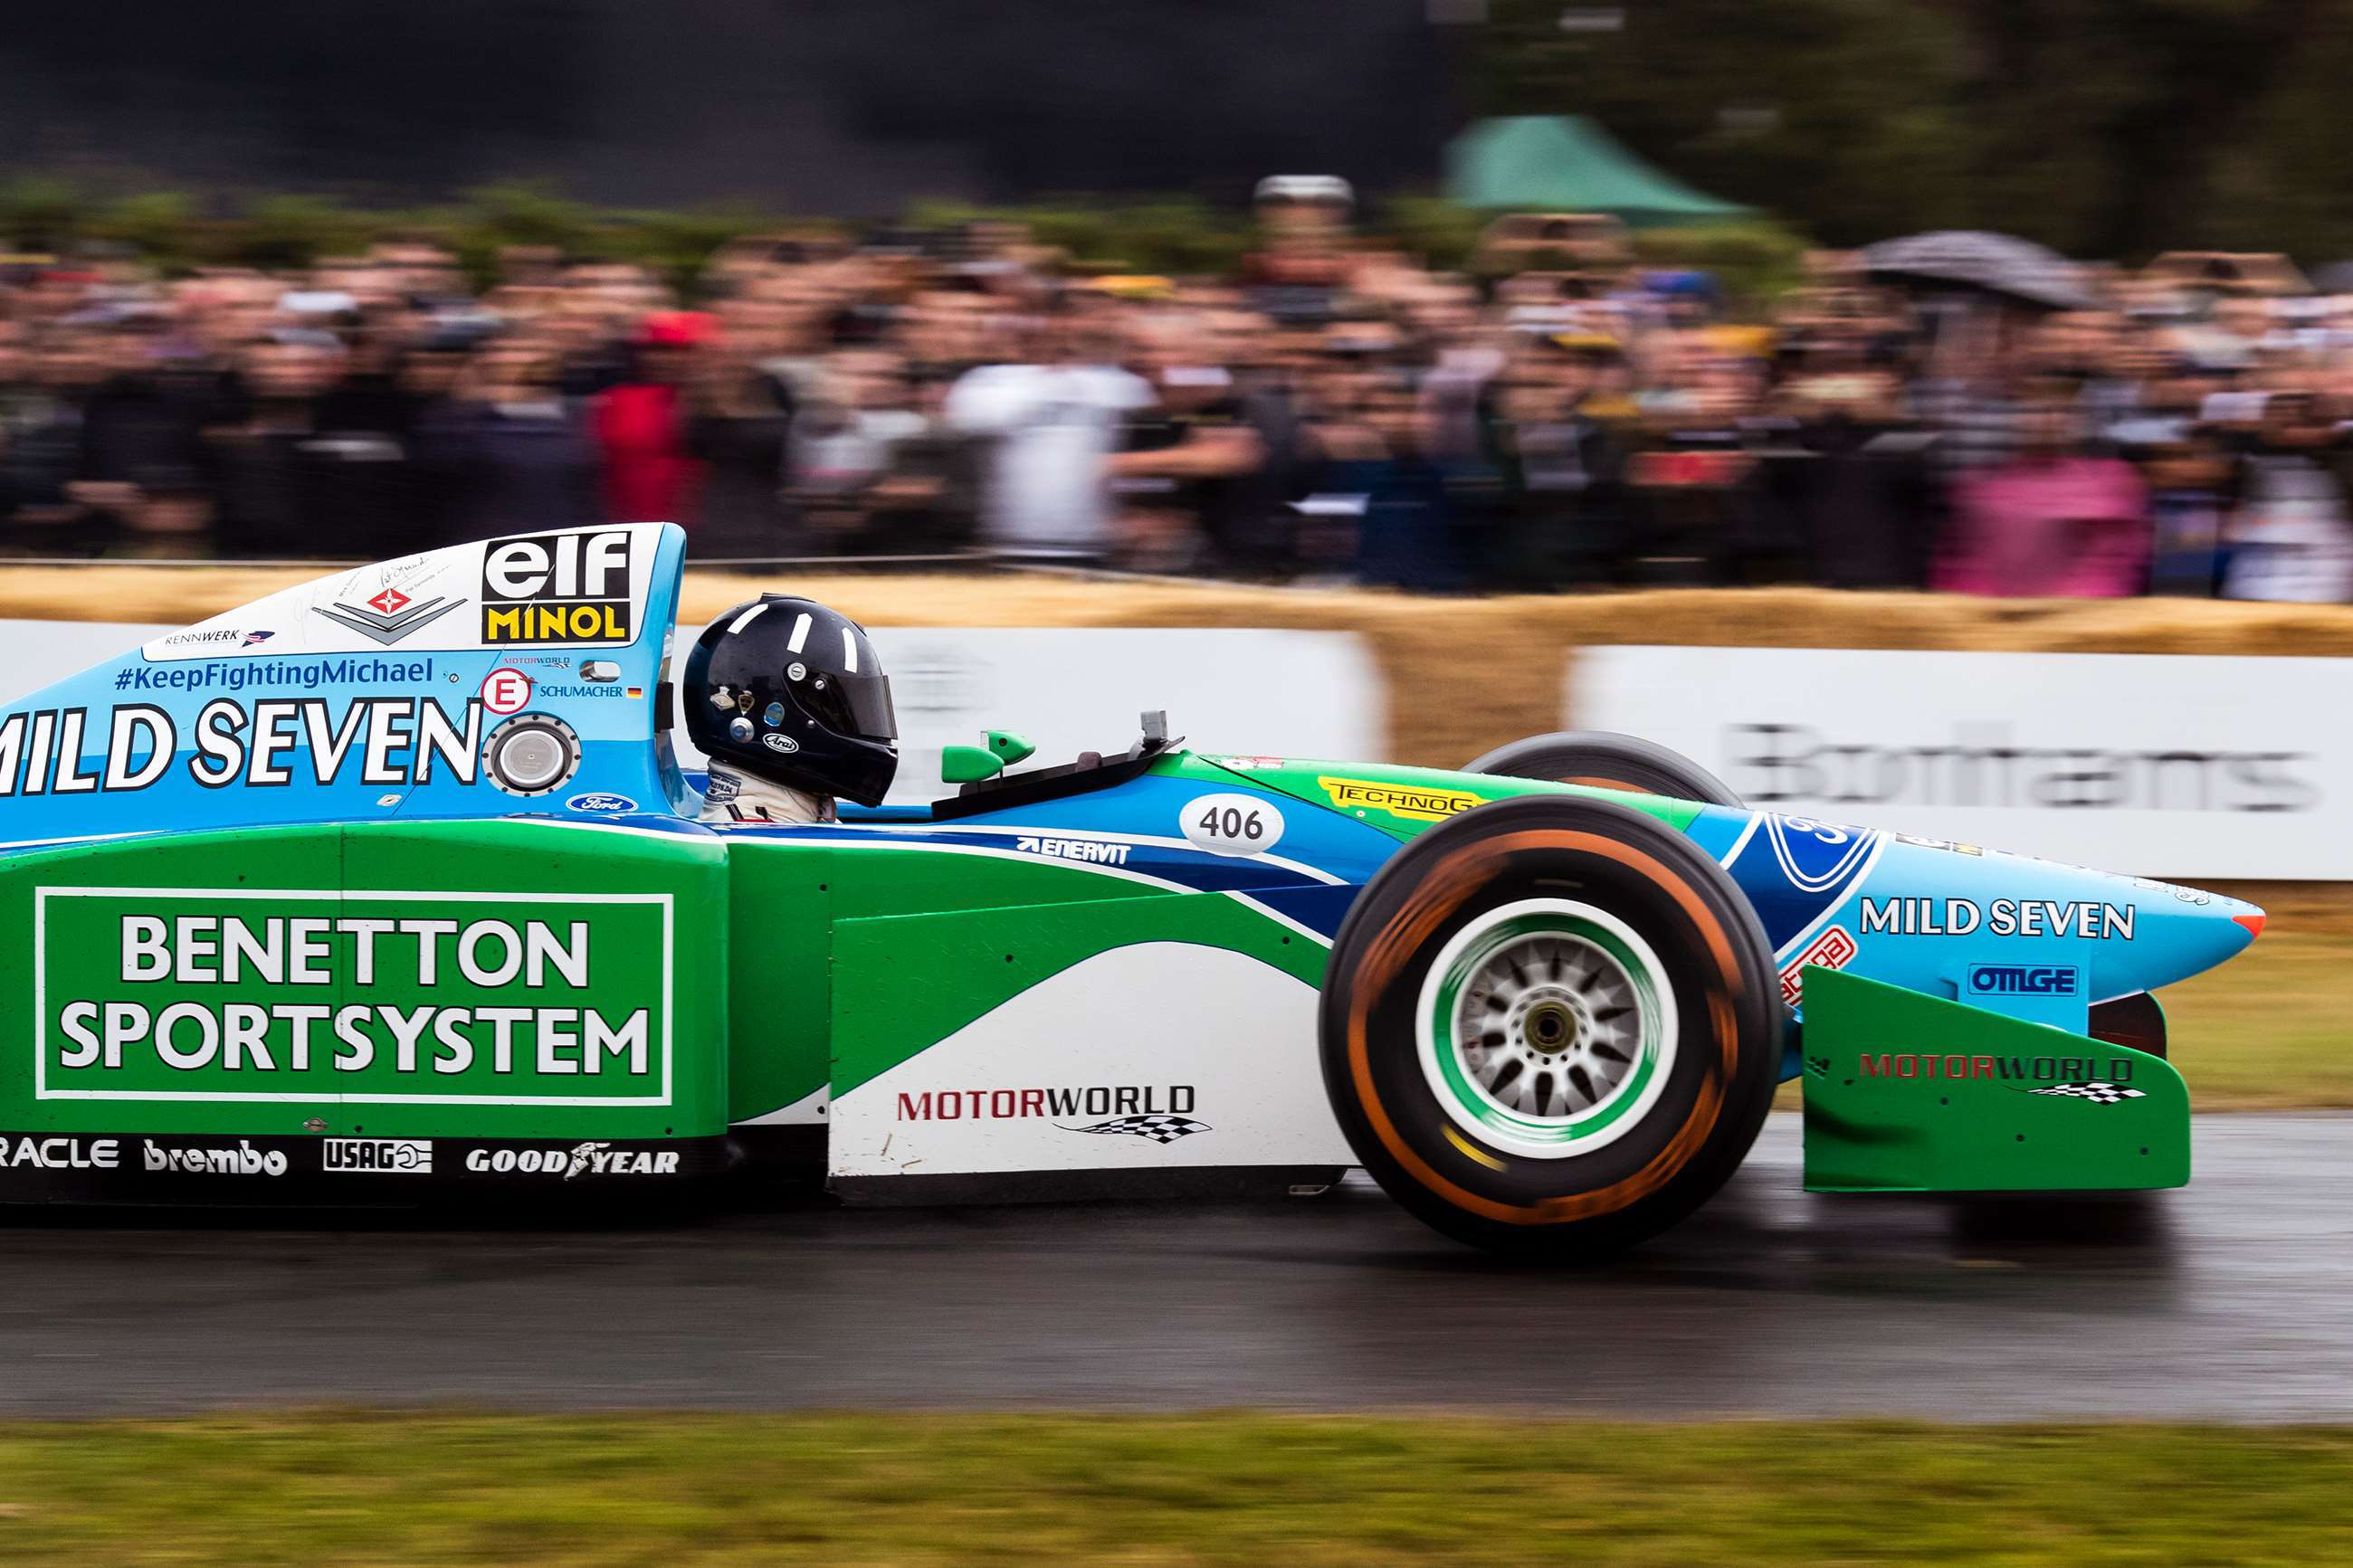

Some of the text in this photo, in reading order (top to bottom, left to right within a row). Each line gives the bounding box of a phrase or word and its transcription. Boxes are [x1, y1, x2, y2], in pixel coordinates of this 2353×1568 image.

[486, 532, 627, 599] elf
[165, 629, 240, 645] RENNWERK
[488, 604, 625, 640] MINOL
[115, 658, 433, 692] #KeepFightingMichael
[495, 679, 517, 705] E
[539, 686, 623, 698] SCHUMACHER
[187, 696, 485, 790] SEVEN
[581, 796, 622, 811] Ford
[1199, 806, 1262, 840] 406
[1860, 897, 2135, 941] MILD SEVEN
[120, 914, 589, 988] BENETTON
[59, 1001, 650, 1075] SPORTSYSTEM
[1860, 1053, 2134, 1082] MOTORWORLD
[897, 1085, 1195, 1121] MOTORWORLD
[144, 1139, 288, 1176] brembo
[325, 1141, 395, 1170] USAG
